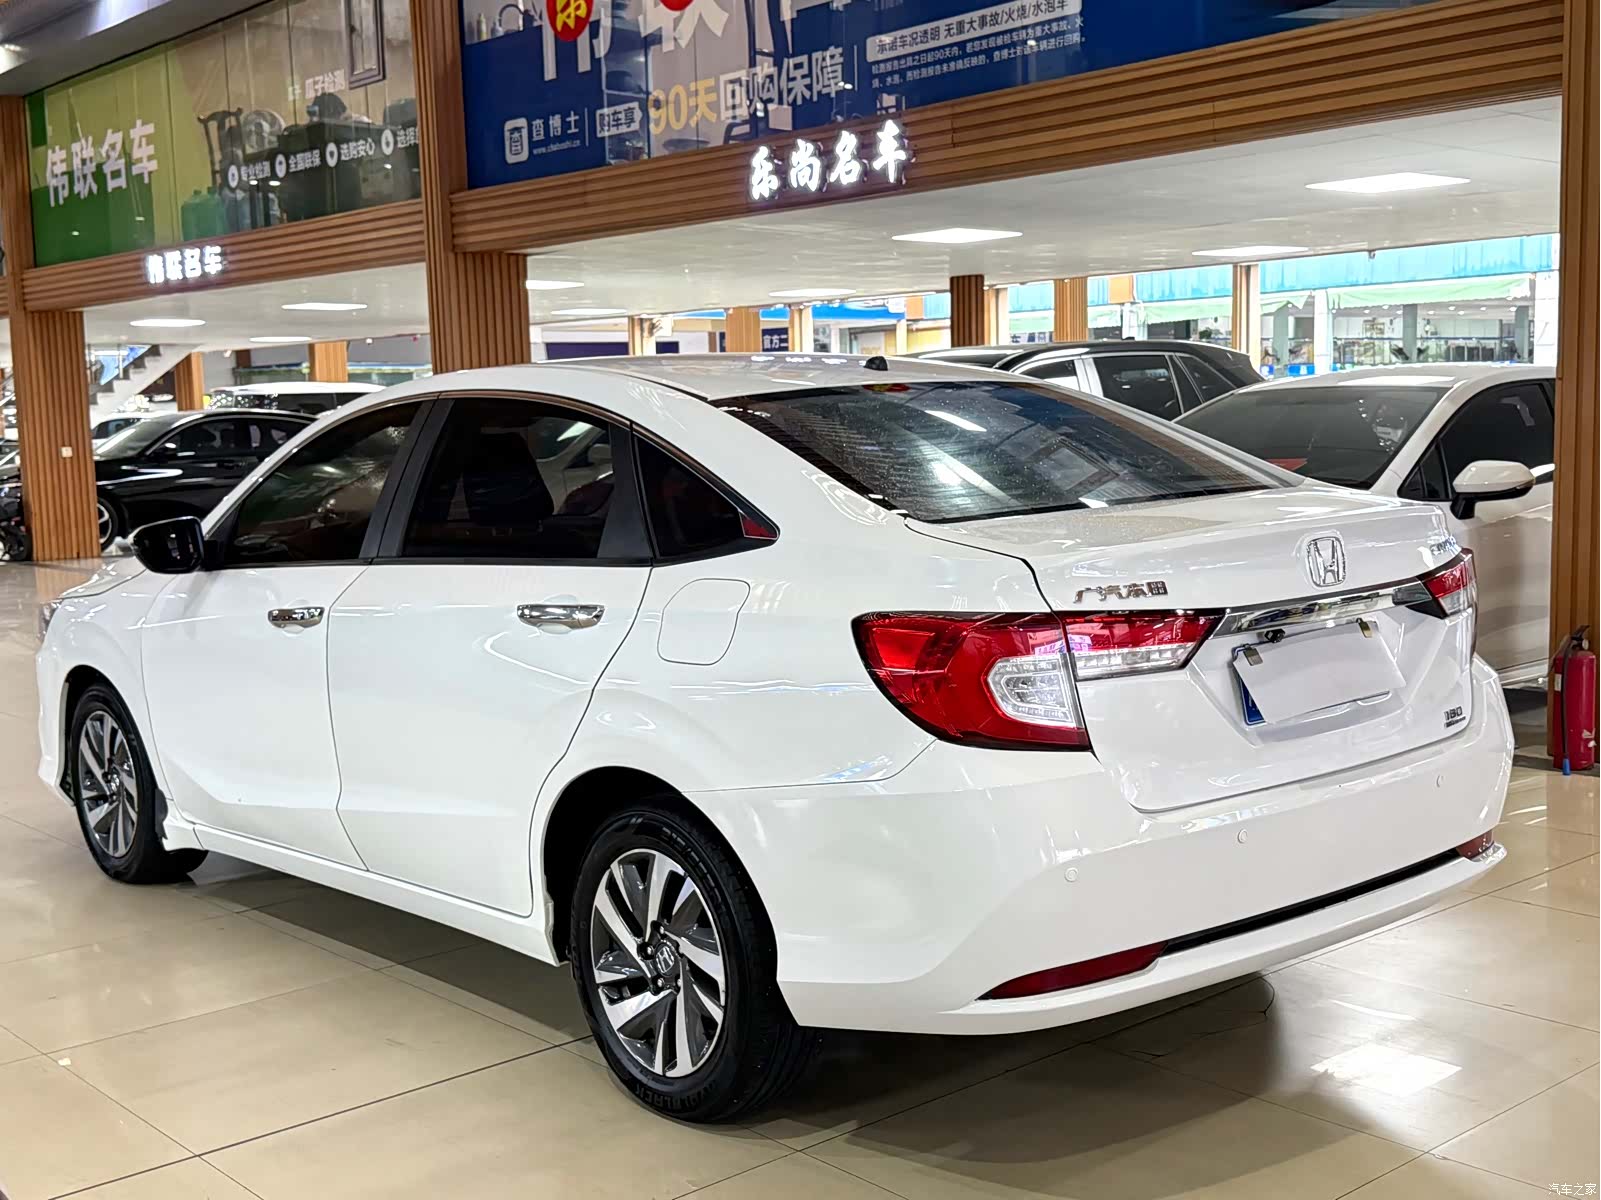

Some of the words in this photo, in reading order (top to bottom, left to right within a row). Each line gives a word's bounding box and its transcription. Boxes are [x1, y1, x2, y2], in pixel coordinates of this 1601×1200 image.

[649, 46, 844, 134] 90天回购保障
[531, 110, 579, 141] 查博士
[46, 119, 158, 207] 伟联名车
[288, 149, 321, 172] 全国联保
[340, 138, 376, 161] 选购安心
[751, 119, 907, 200] 乐尚名车
[147, 246, 222, 284] 伟联名车
[1073, 580, 1169, 604] 广汽本田
[1444, 705, 1463, 721] 180
